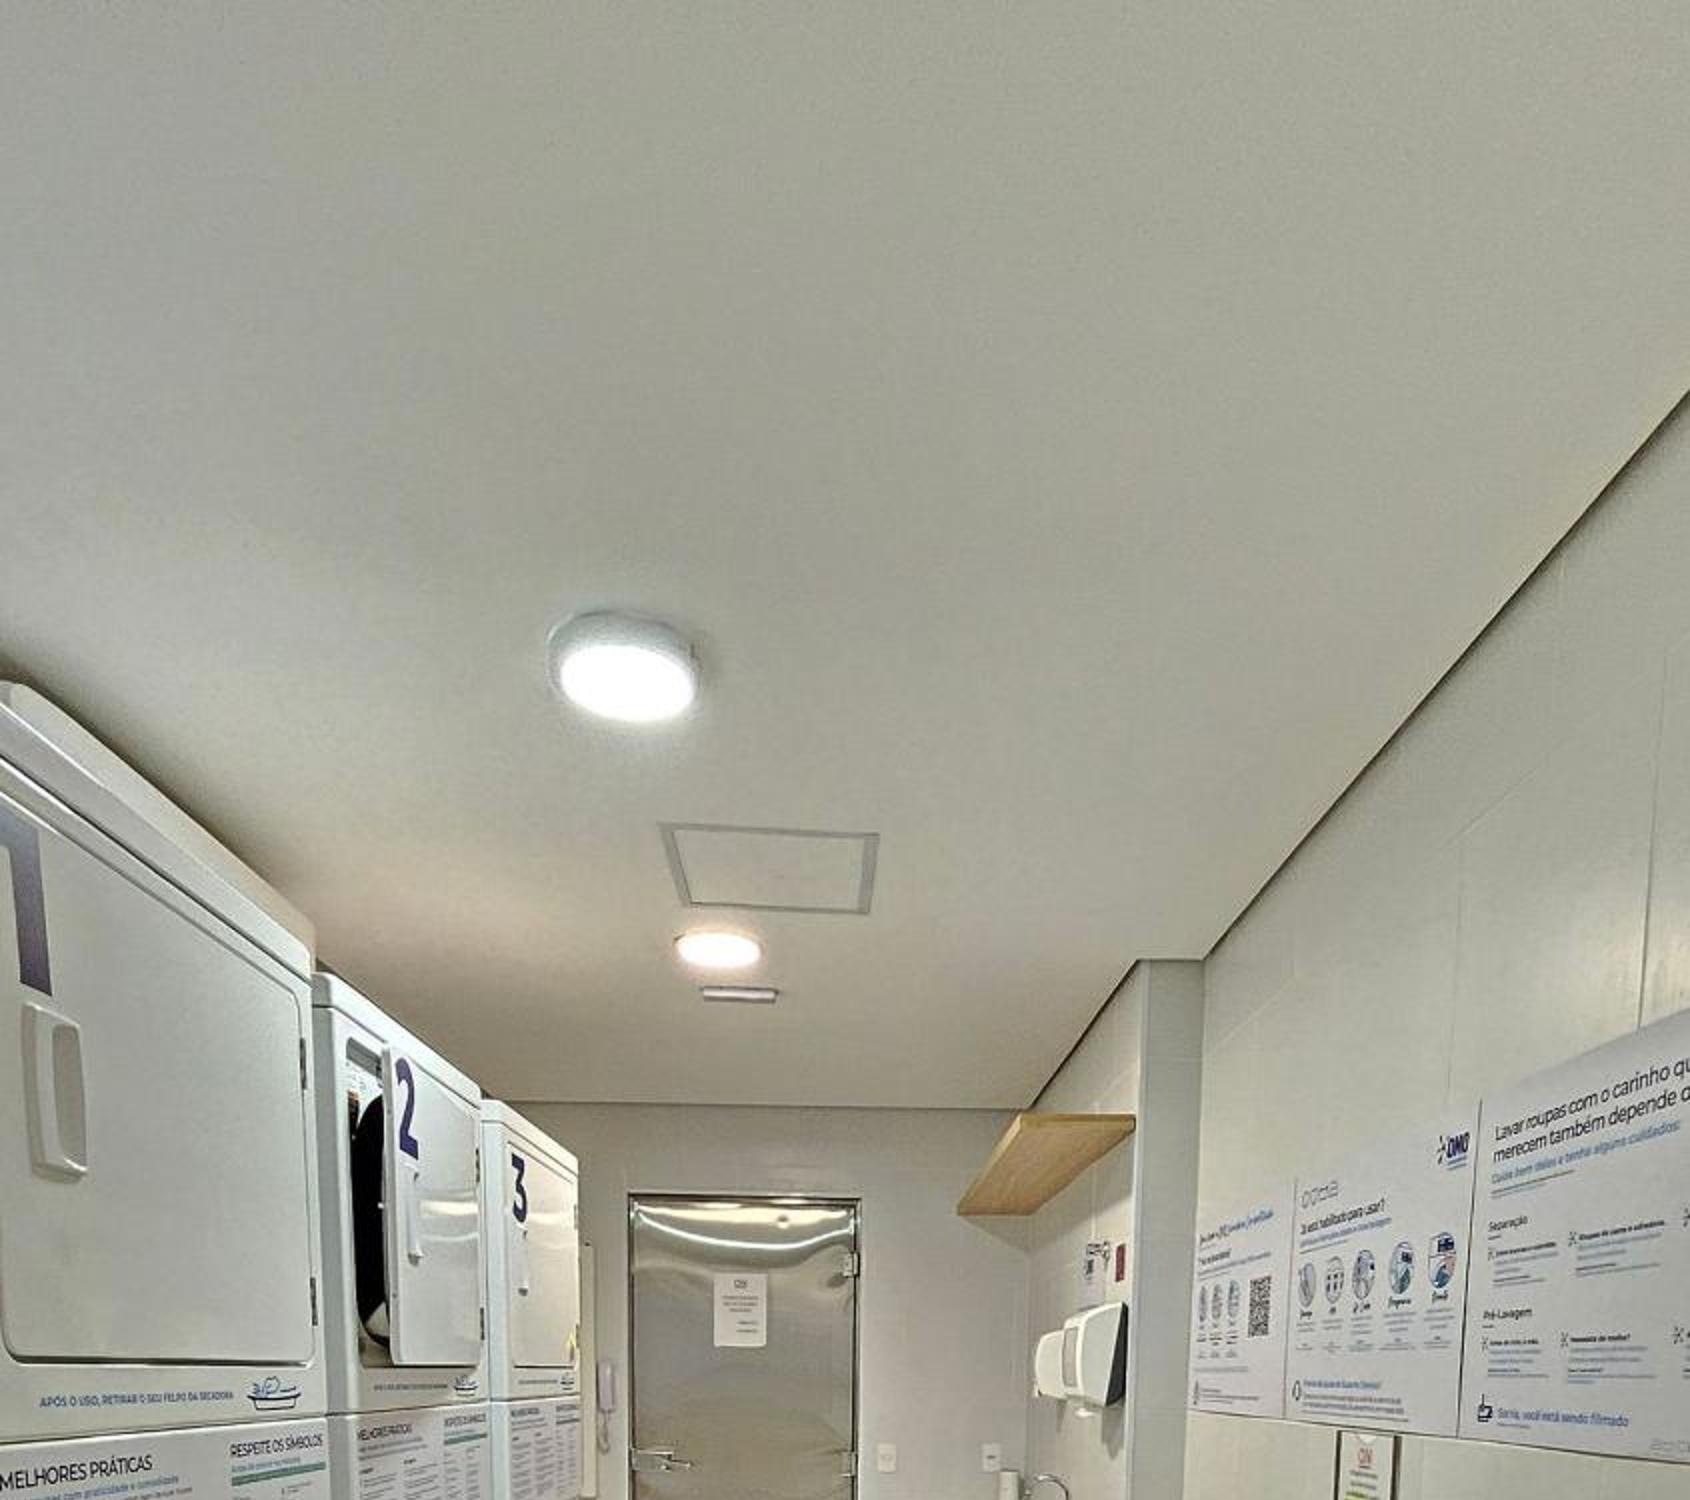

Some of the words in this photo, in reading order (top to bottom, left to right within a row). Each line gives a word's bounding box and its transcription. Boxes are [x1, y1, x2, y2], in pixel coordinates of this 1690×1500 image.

[395, 1057, 419, 1161] 2
[1493, 1135, 1547, 1163] merecem
[1549, 1114, 1605, 1146] também
[1608, 1088, 1677, 1125] depende
[1495, 1118, 1524, 1141] Lavar
[1525, 1104, 1567, 1131] roupas
[1568, 1092, 1599, 1115] com
[1600, 1088, 1610, 1103] o
[1612, 1065, 1671, 1099] carinho
[512, 1154, 528, 1224] 3
[1488, 1214, 1529, 1232] Separação
[40, 1394, 66, 1407] APÓS
[70, 1395, 77, 1407] O
[1589, 1411, 1630, 1427] filmado
[0, 1463, 87, 1491] MELHORES
[89, 1454, 153, 1479] PRÁTICAS
